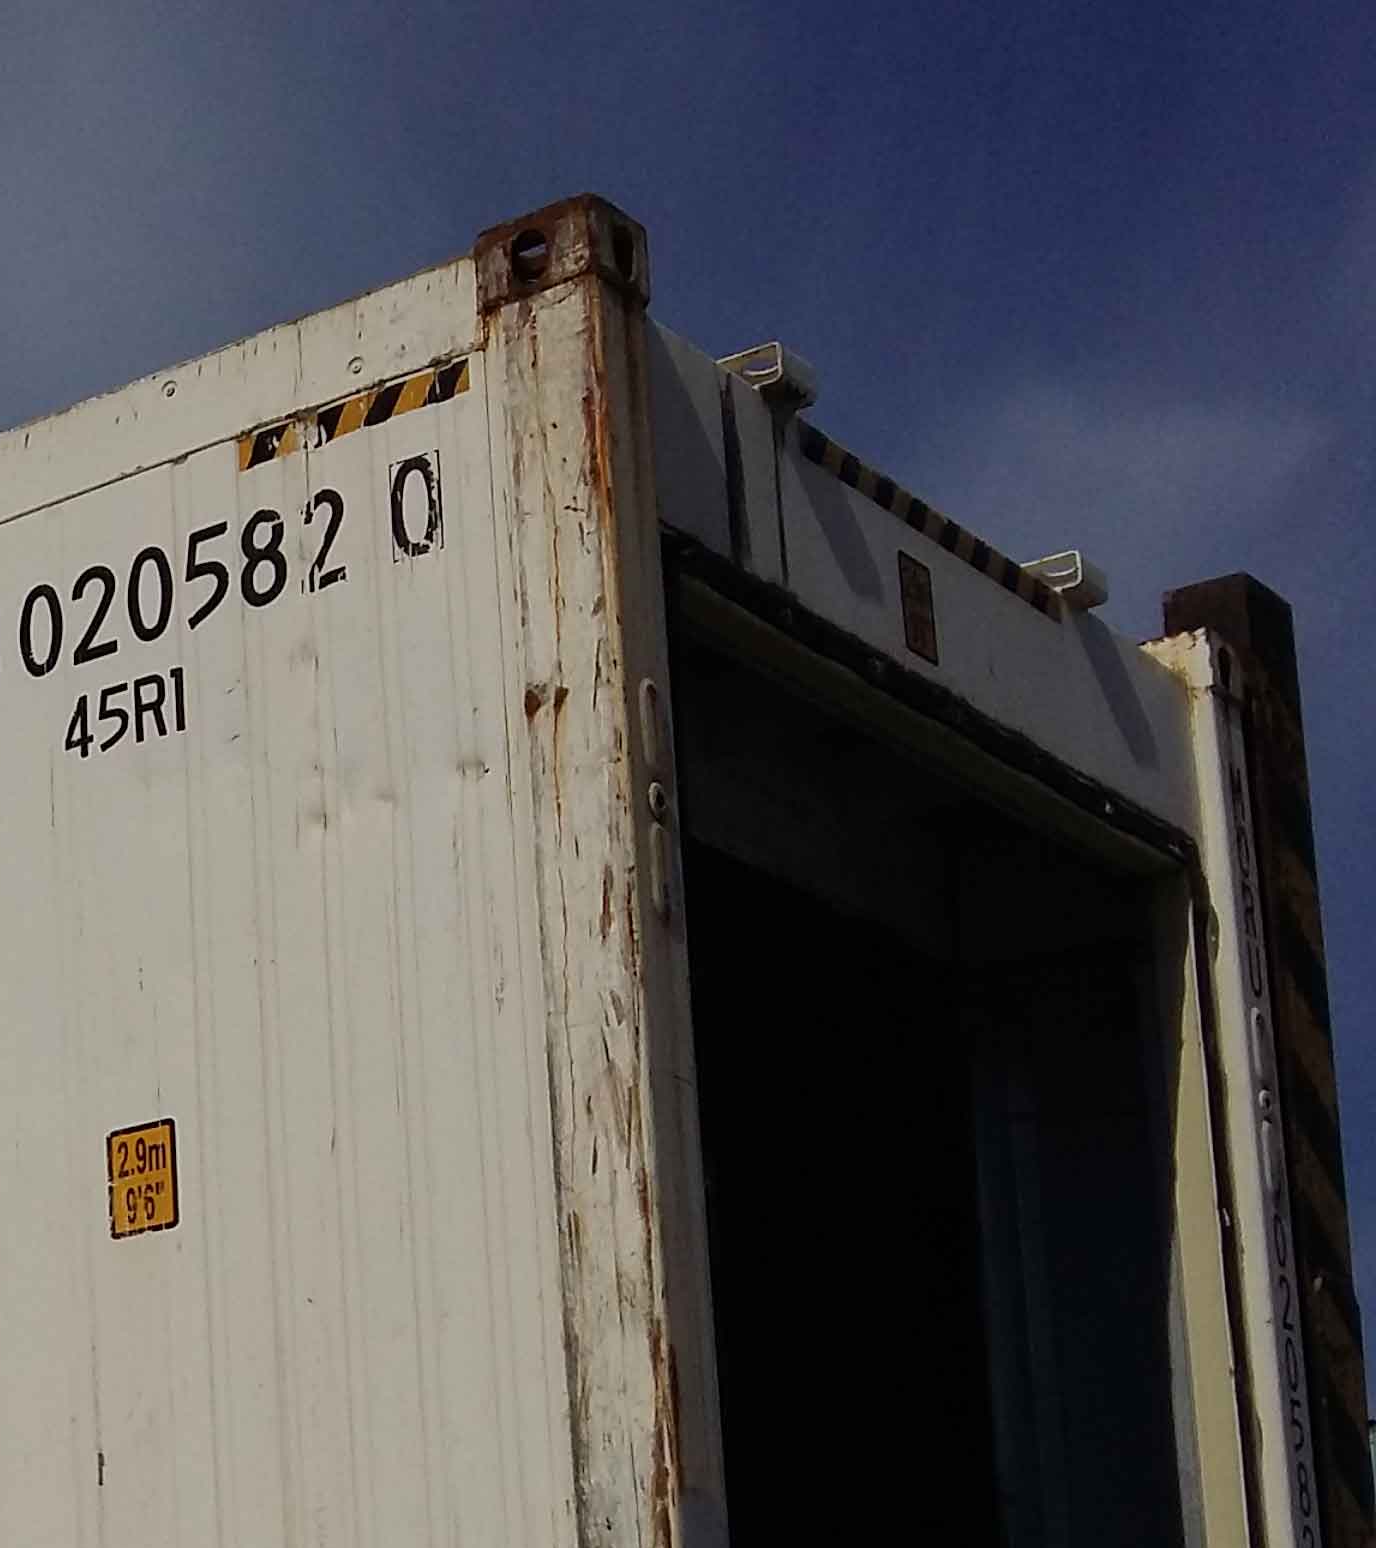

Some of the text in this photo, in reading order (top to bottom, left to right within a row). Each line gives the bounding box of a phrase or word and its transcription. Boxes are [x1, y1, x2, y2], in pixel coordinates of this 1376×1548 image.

[19, 488, 348, 679] 020582
[390, 454, 441, 558] 0
[64, 667, 186, 758] 45R1
[117, 1136, 166, 1179] 2.9m
